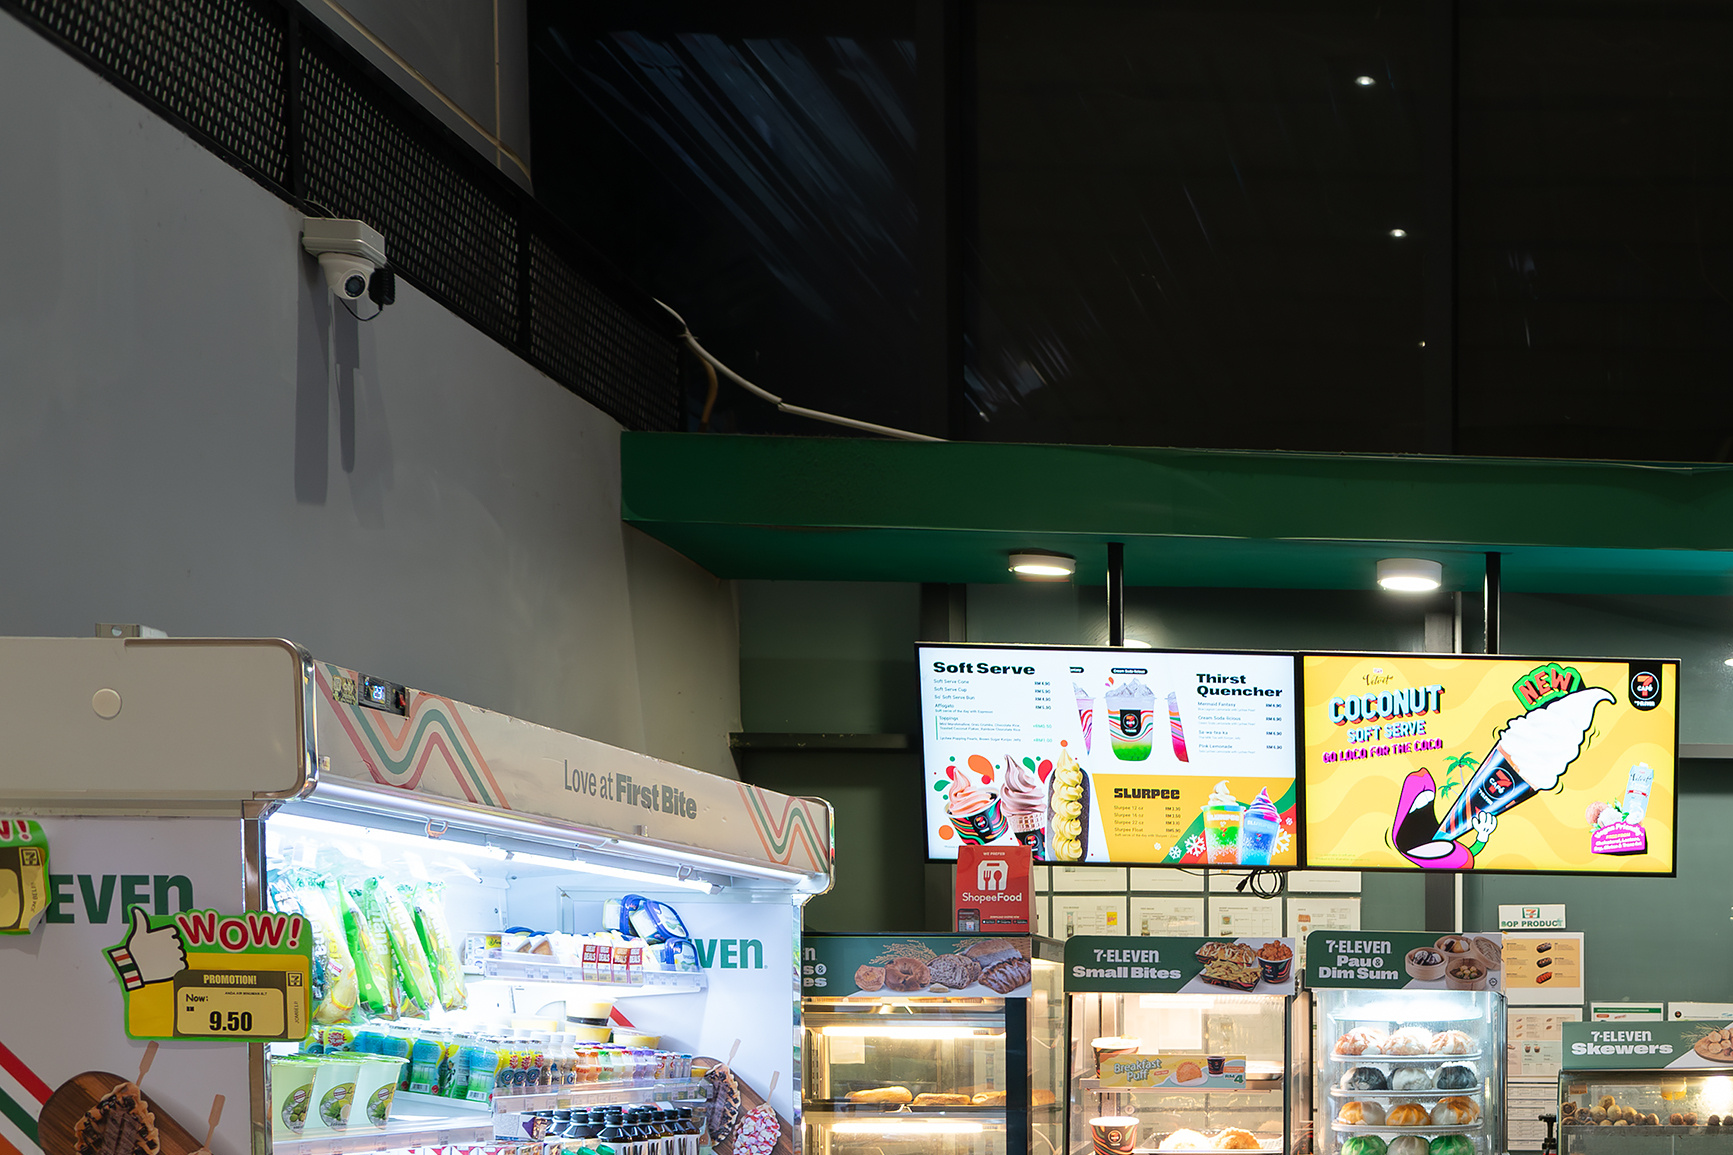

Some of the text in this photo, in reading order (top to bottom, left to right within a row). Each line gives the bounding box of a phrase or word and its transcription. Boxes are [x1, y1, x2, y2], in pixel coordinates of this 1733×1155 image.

[933, 661, 1036, 675] Soft Serve
[1196, 673, 1246, 684] Thirst
[1196, 685, 1283, 698] Quencher
[1518, 668, 1574, 705] NEW
[1329, 684, 1446, 726] COCONUT
[1347, 719, 1427, 744] SOFT SERVE
[1322, 738, 1443, 763] GO LOCO FOR THE COCO
[563, 759, 698, 820] Love at First Bite
[1114, 788, 1180, 800] SLURPEE
[962, 892, 1023, 904] ShopeeFood
[1521, 919, 1563, 928] PRODUCT
[176, 911, 303, 952] WOW!
[1336, 955, 1371, 968] Pau
[203, 974, 257, 985] PROMOTION!
[1072, 966, 1182, 980] Small Bites
[1318, 967, 1399, 980] Dim Sum
[186, 993, 209, 1002] Now:
[209, 1011, 253, 1032] 9.50
[1571, 1042, 1674, 1056] Skewers
[1113, 1058, 1162, 1074] Breakfast
[1126, 1071, 1149, 1083] Puff
